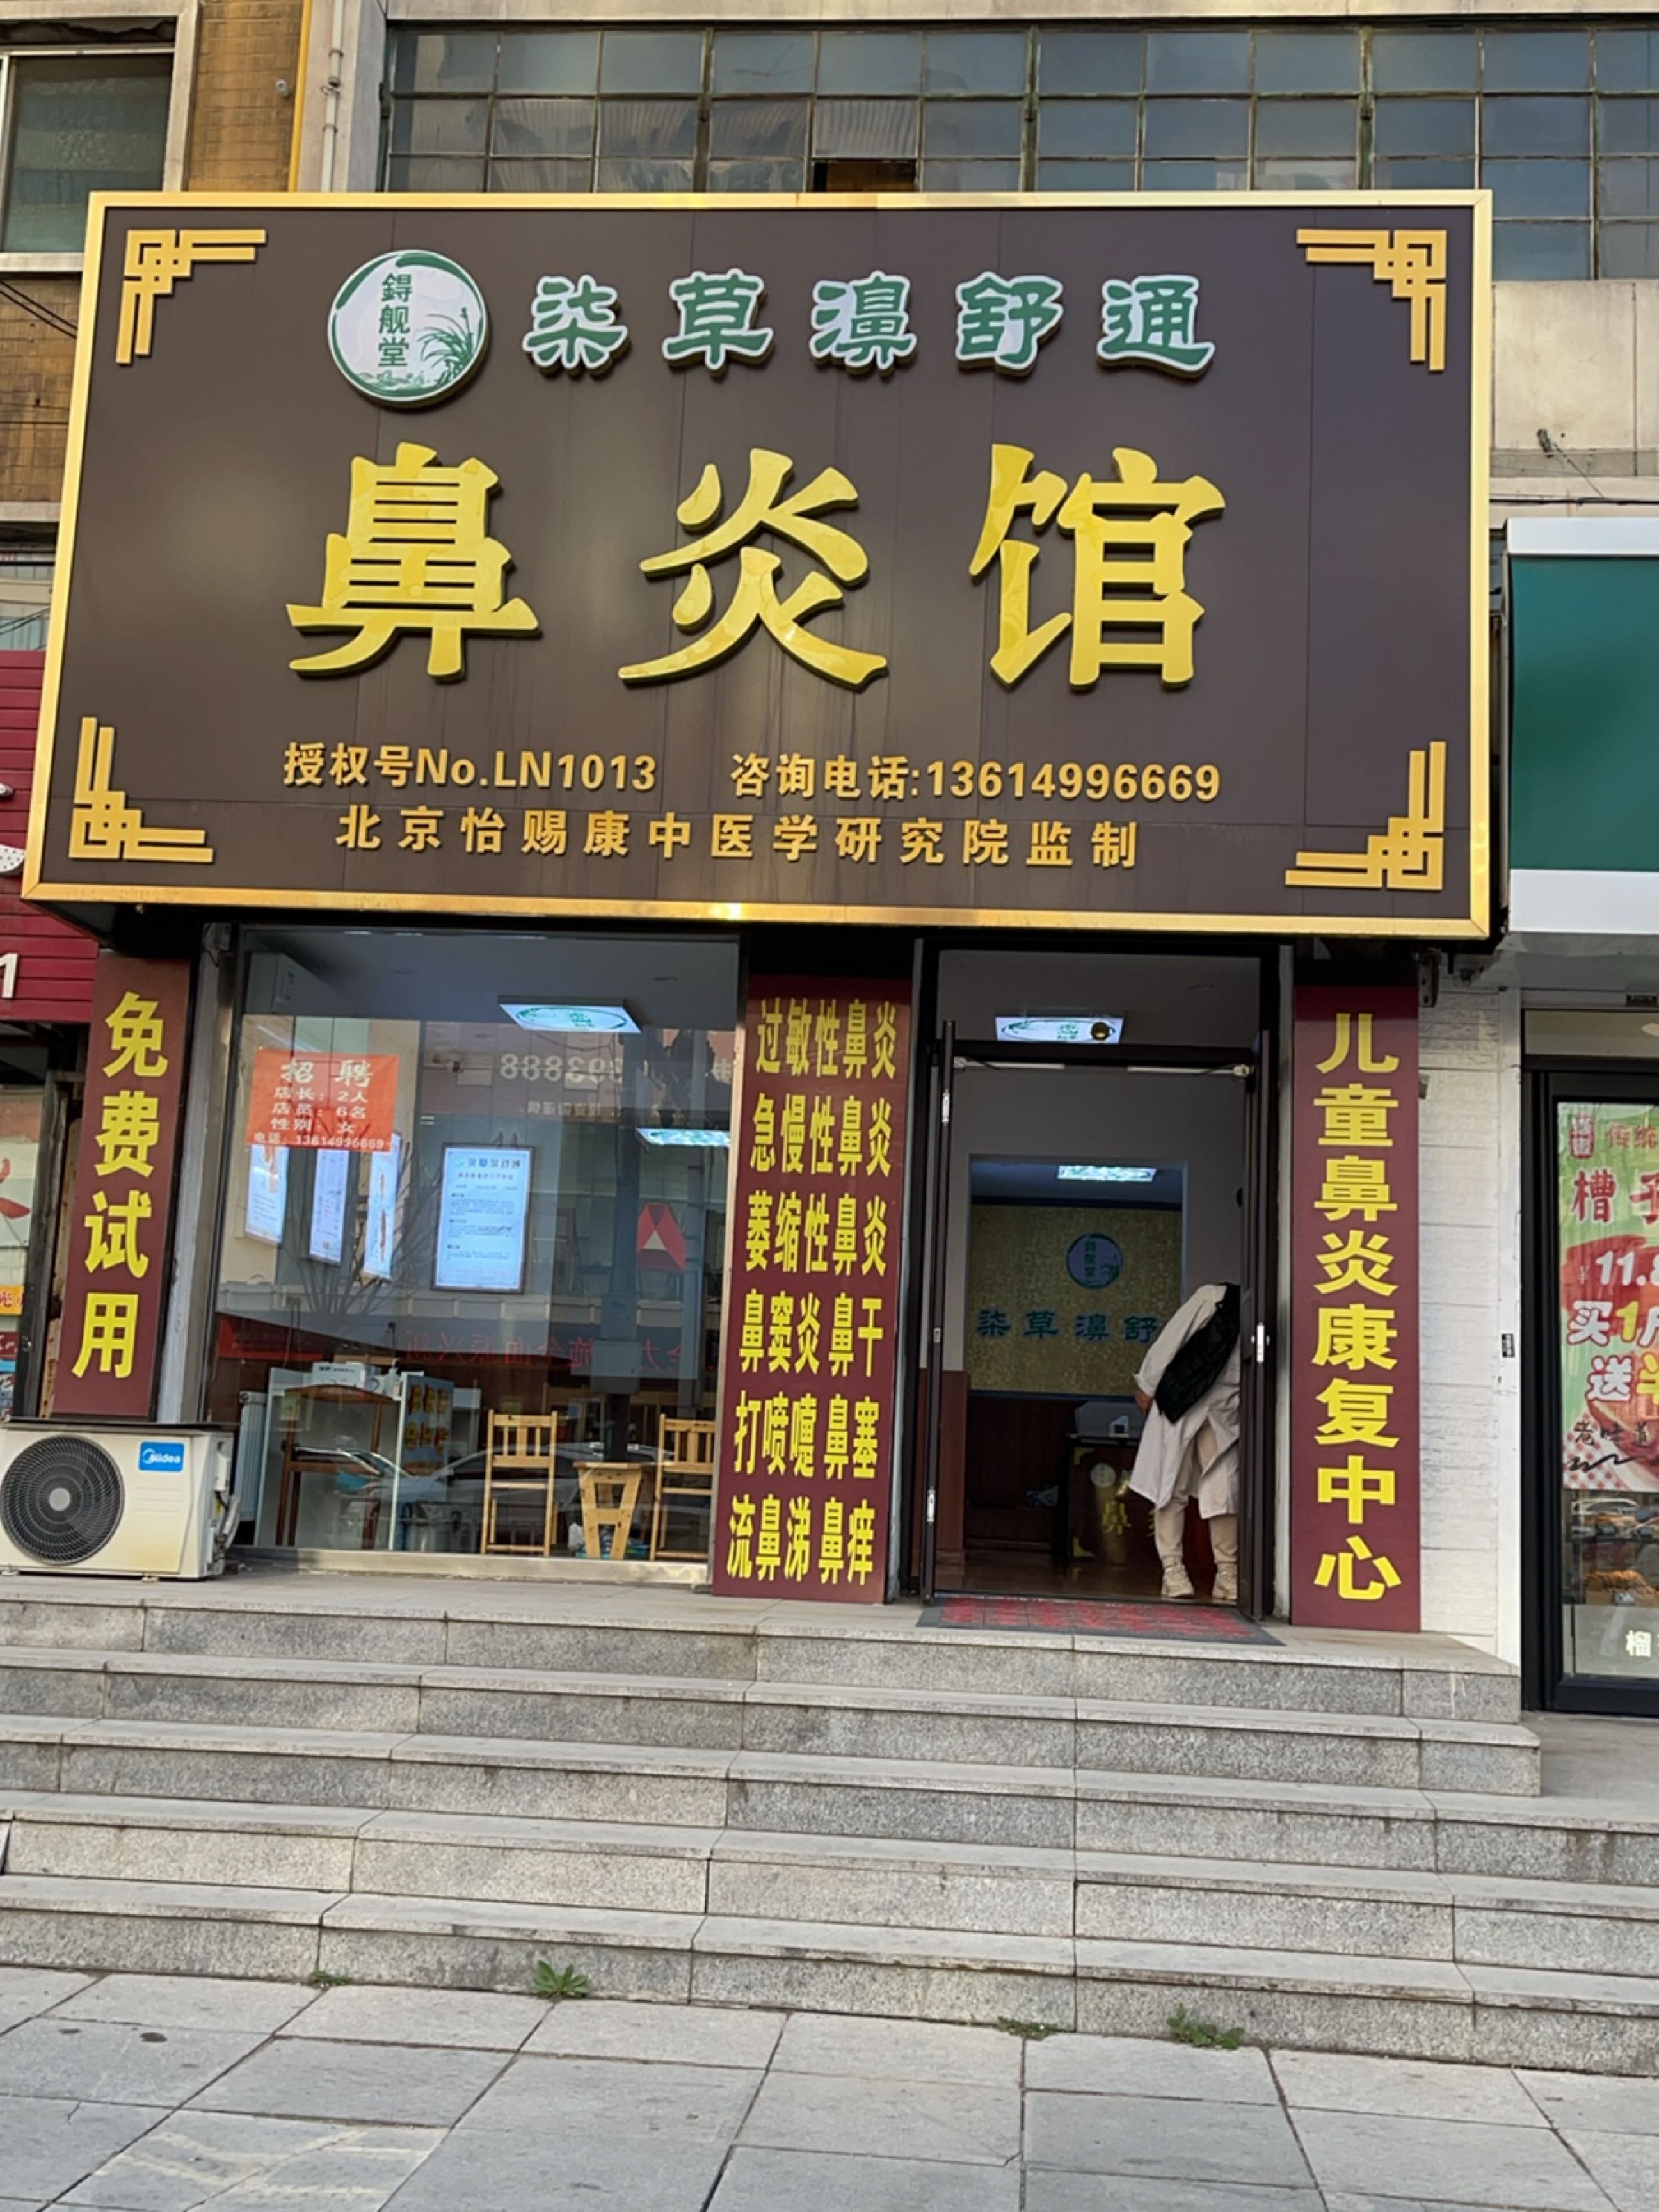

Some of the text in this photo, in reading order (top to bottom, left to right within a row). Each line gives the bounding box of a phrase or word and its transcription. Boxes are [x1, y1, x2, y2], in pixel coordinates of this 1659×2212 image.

[522, 269, 1215, 376] 柒草濞舒通
[285, 442, 1226, 689] 鼻炎馆
[283, 742, 1221, 801] 授权号No.LN1013 咨询电话:13614996669
[335, 804, 1137, 868] 北京怡赐康中医学研究院监制
[280, 1058, 374, 1087] 招聘
[755, 997, 896, 1080] 过敏性鼻炎
[749, 1092, 892, 1177] 急慢性鼻炎
[72, 991, 169, 1379] 免费试用
[746, 1189, 887, 1276] 萎缩性鼻炎
[1312, 1012, 1402, 1601] 儿童鼻炎康复中心
[1626, 1630, 1659, 1656] 榴
